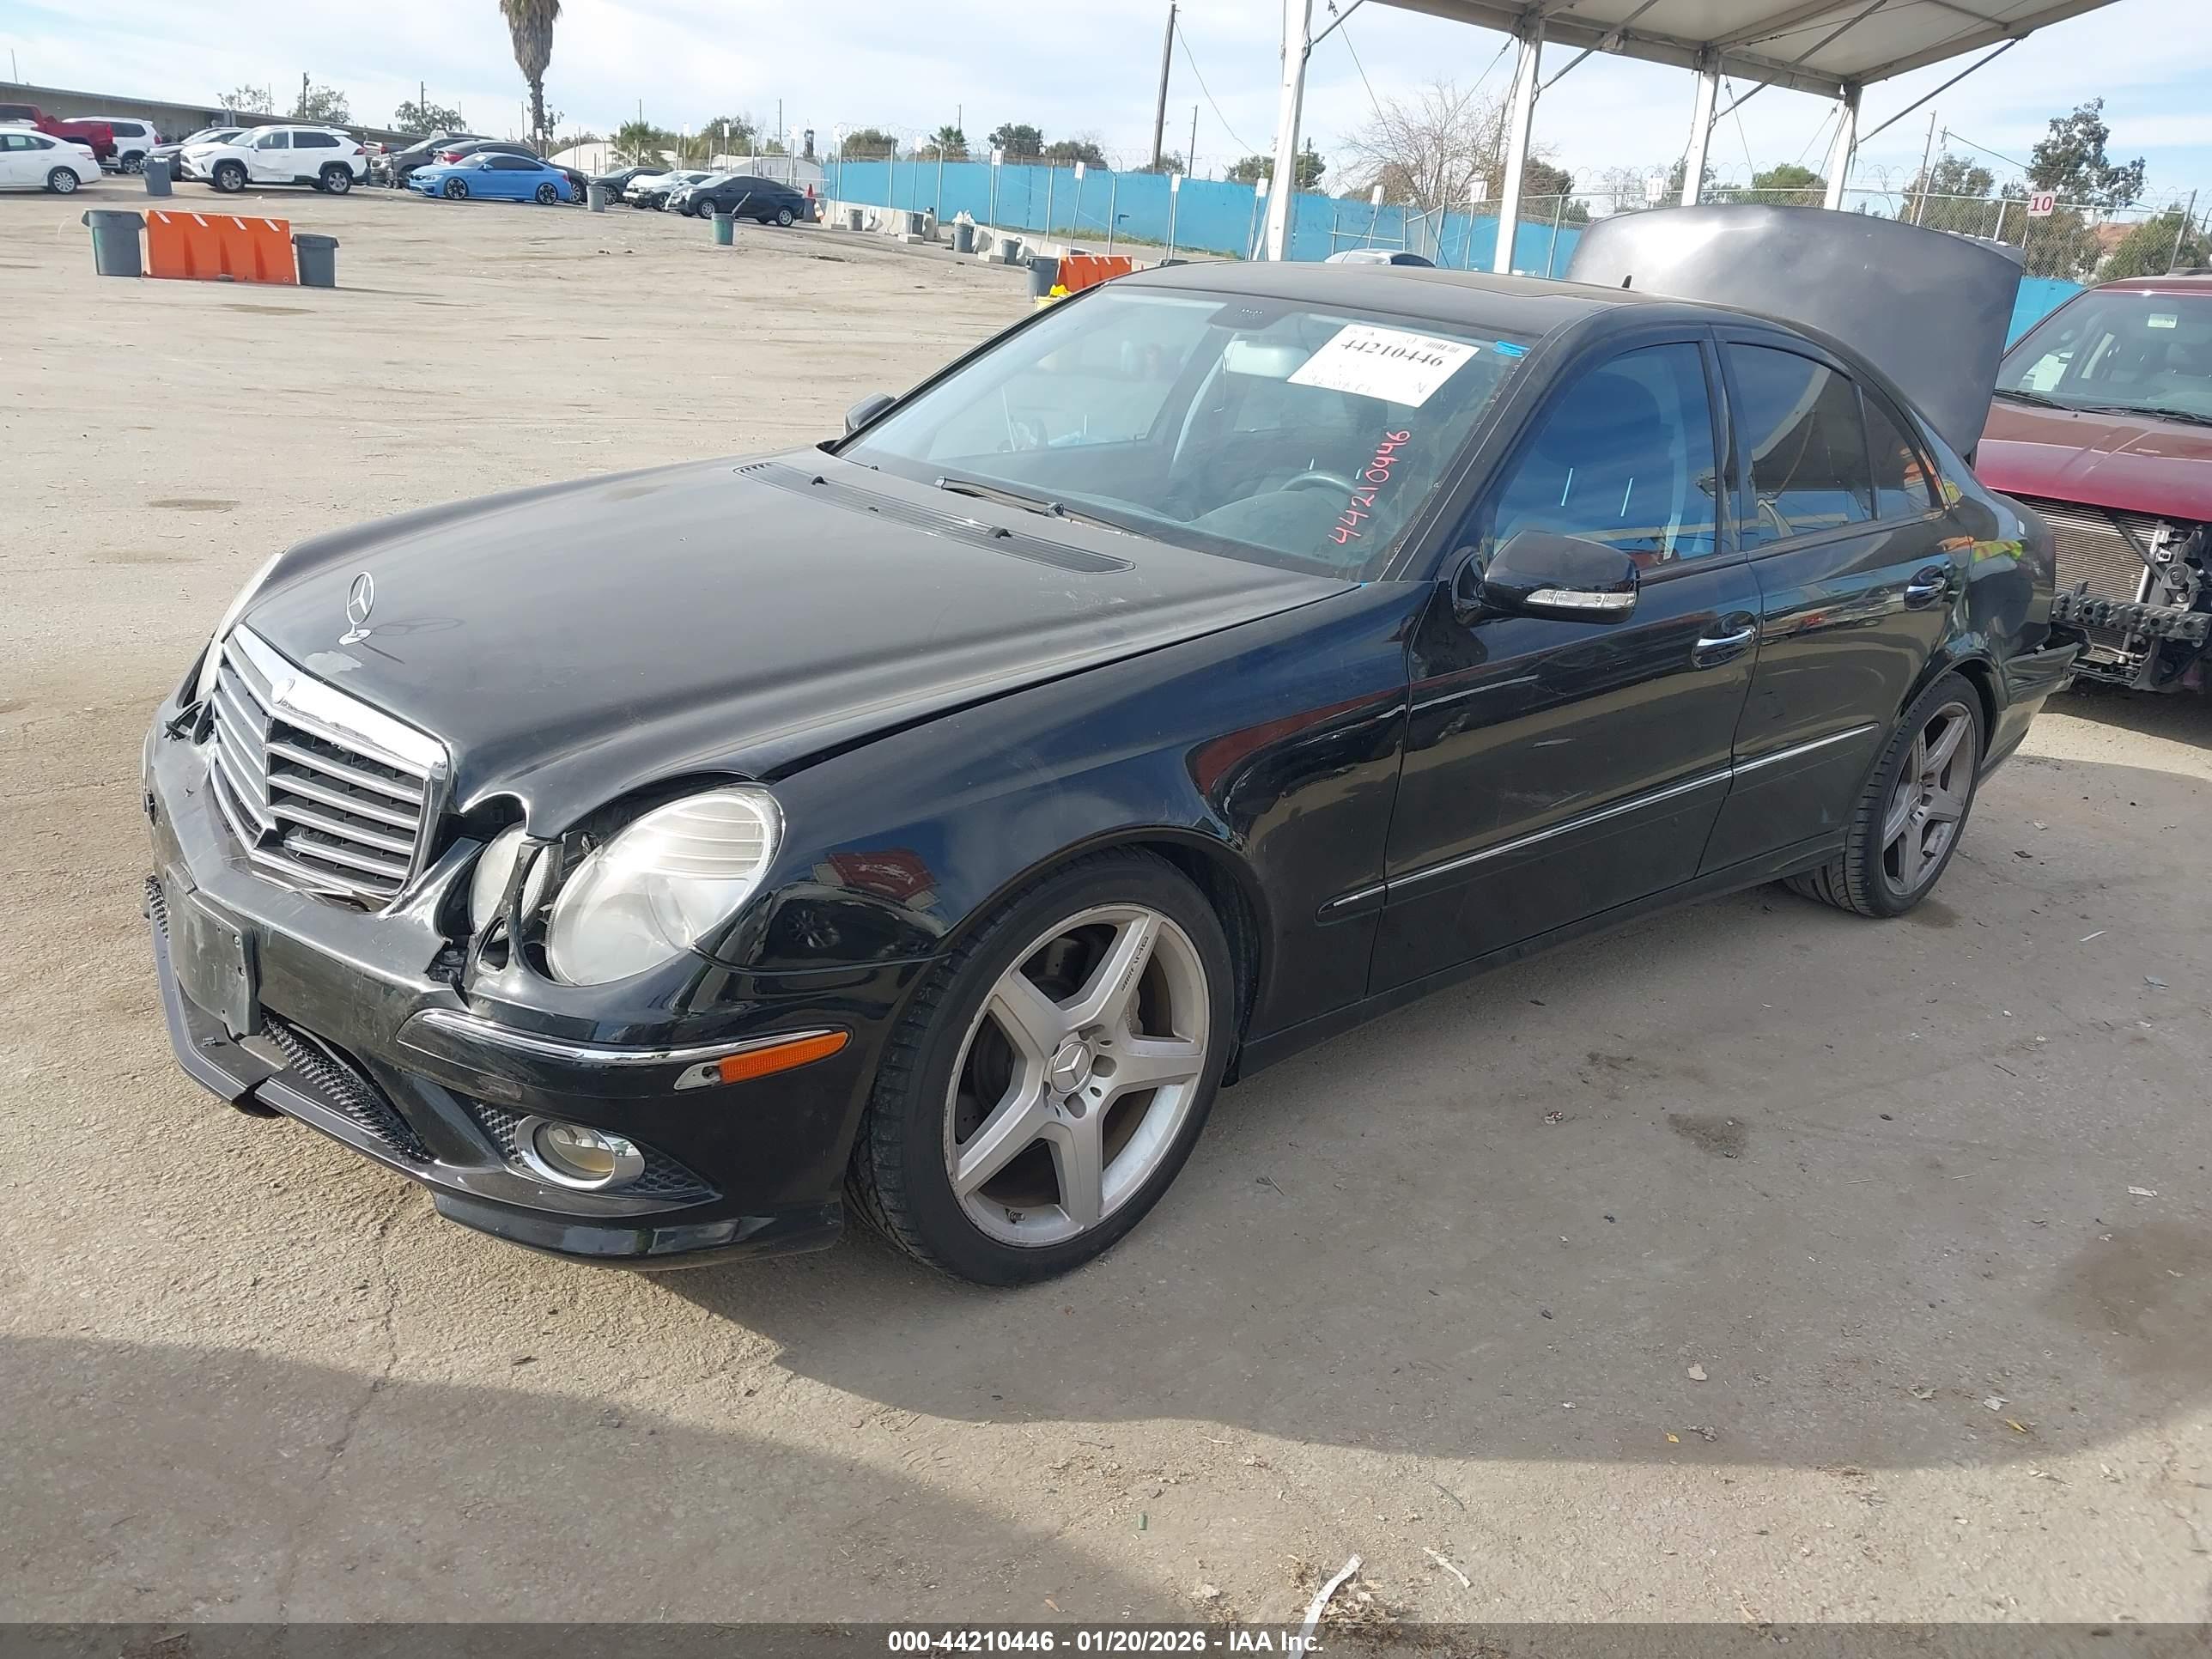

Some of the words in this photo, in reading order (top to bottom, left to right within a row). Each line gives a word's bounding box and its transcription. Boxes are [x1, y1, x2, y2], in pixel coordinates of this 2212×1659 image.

[2030, 196, 2053, 211] 10
[1340, 339, 1443, 367] 44210446
[1328, 430, 1410, 544] 44210446
